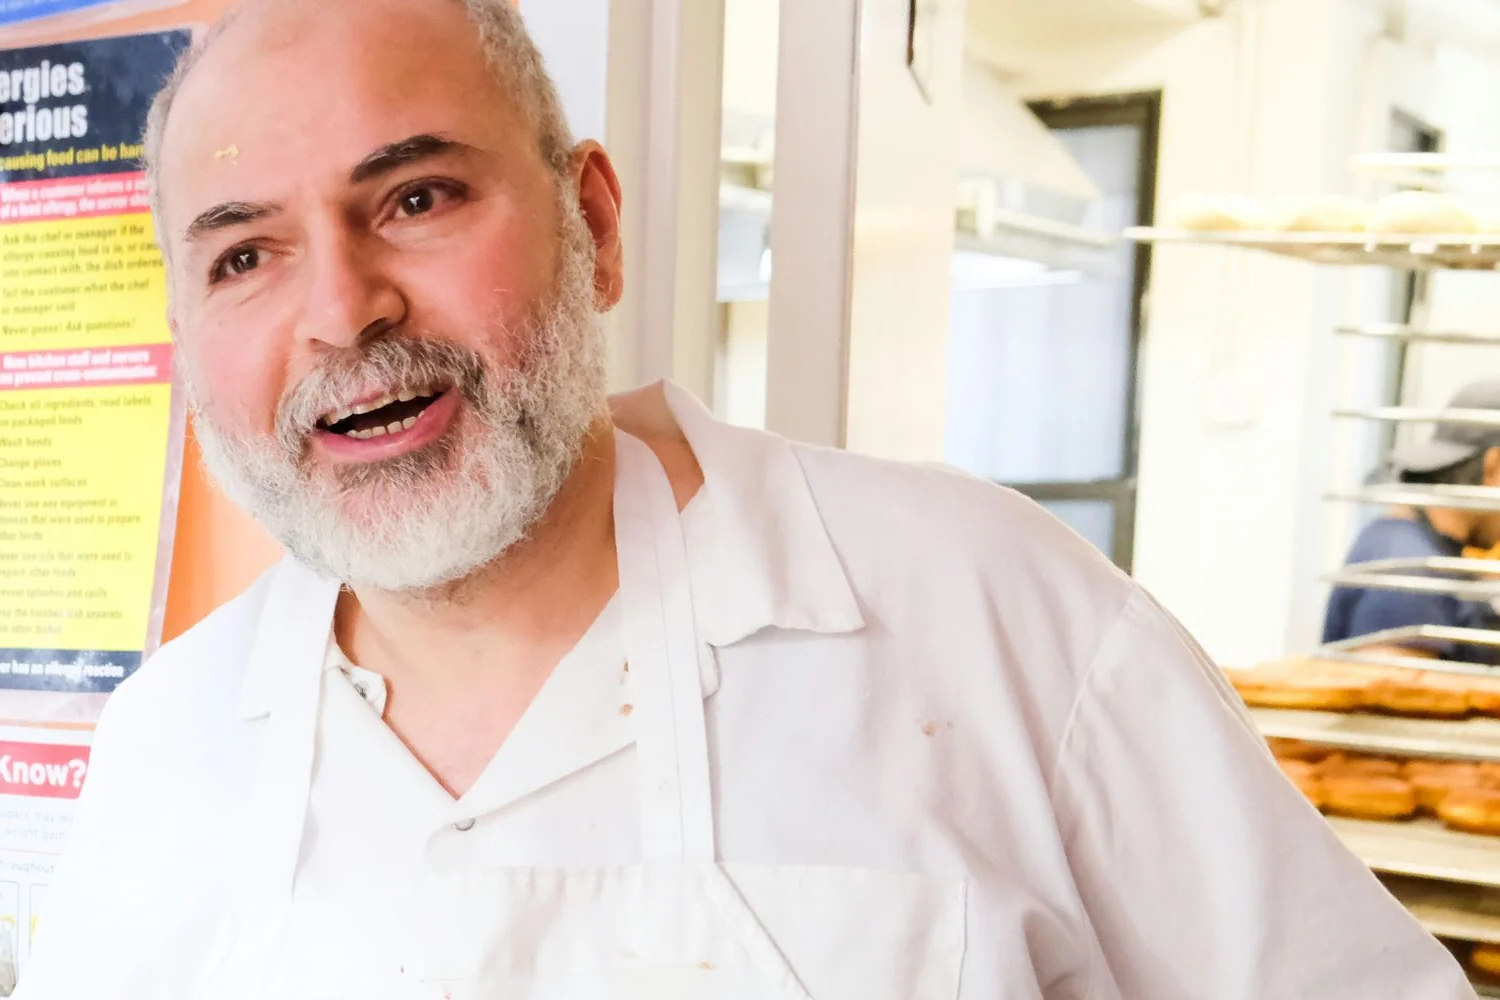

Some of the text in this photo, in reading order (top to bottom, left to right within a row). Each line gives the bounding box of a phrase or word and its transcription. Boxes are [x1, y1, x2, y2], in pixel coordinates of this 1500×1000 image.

[46, 147, 74, 167] food
[76, 148, 99, 164] can
[101, 144, 117, 162] be
[3, 235, 19, 245] Ask
[23, 233, 36, 243] the
[75, 229, 117, 241] manager
[120, 225, 127, 236] if
[129, 224, 144, 235] the
[38, 284, 80, 296] customer
[83, 280, 108, 293] what
[110, 280, 124, 291] the
[128, 278, 150, 289] chef
[13, 303, 52, 315] manager
[2, 324, 28, 336] Never
[66, 320, 81, 331] Ask
[0, 394, 151, 410] Check all read labels
[11, 415, 56, 429] packaged
[26, 436, 52, 446] hands
[33, 457, 62, 469] gloves
[25, 478, 46, 487] work
[50, 477, 87, 487] surfaces
[25, 499, 39, 508] use
[42, 499, 57, 510] any
[60, 498, 107, 510] equipment
[31, 514, 47, 524] that
[50, 515, 71, 524] were
[74, 514, 93, 524] used
[107, 514, 141, 525] prepare
[77, 553, 99, 561] were
[102, 551, 121, 561] used
[86, 610, 122, 620] separate
[11, 659, 30, 675] has
